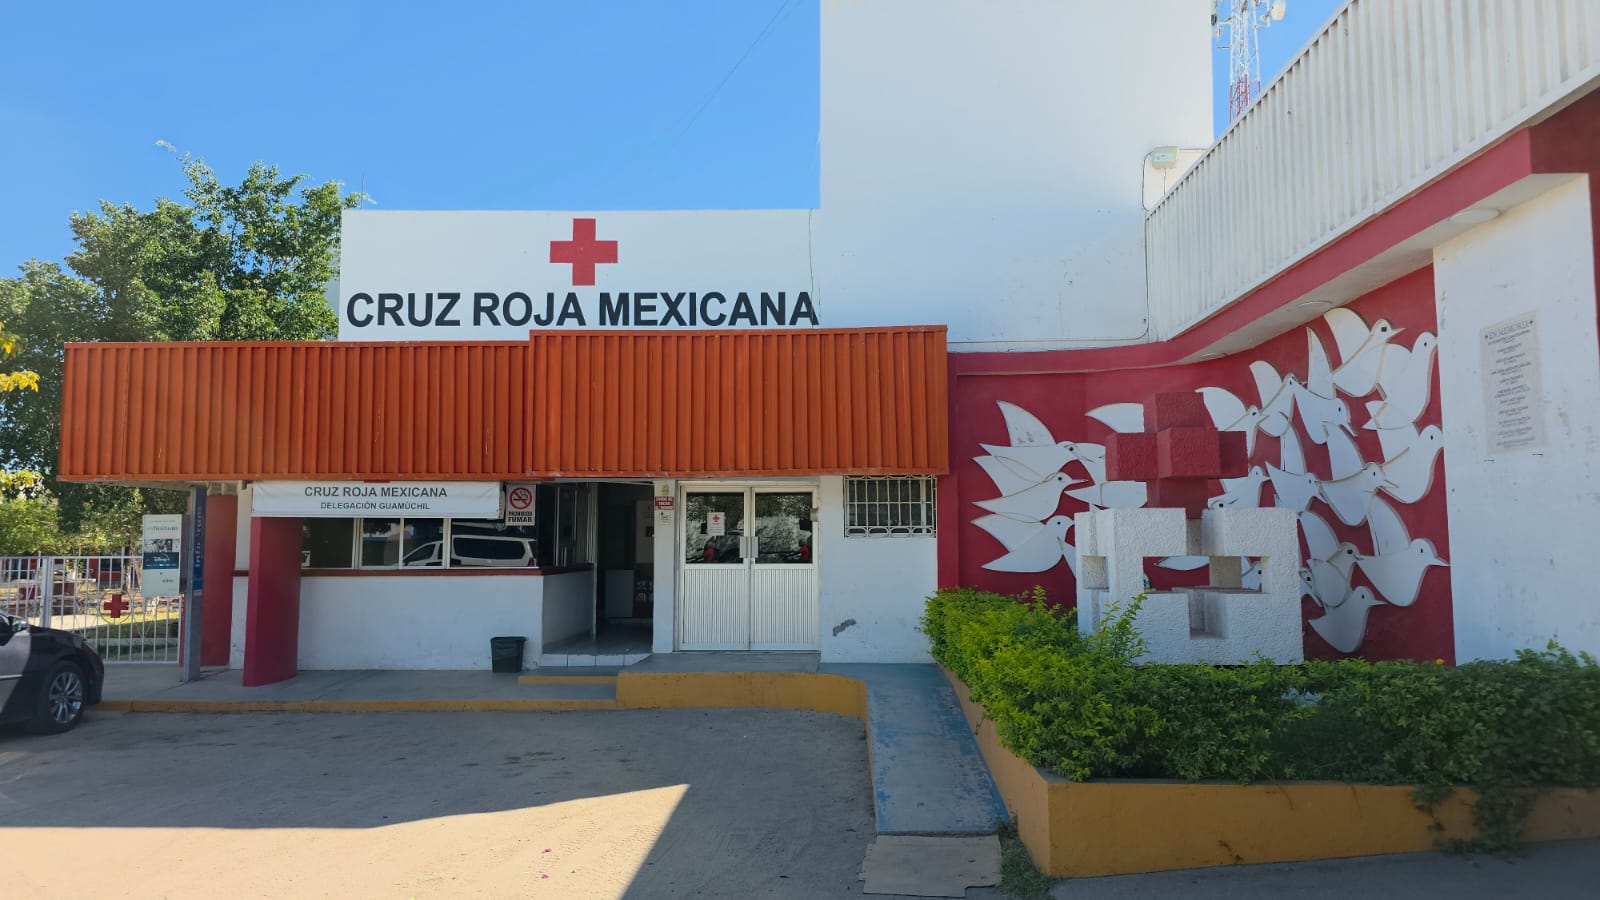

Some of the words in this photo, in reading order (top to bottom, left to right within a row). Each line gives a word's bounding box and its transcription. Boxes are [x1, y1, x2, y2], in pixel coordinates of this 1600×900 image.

[346, 292, 461, 327] CRUZ
[473, 291, 587, 327] ROJA
[598, 291, 820, 327] MEXICANA
[304, 486, 340, 497] CRUZ
[342, 486, 378, 497] ROJA
[380, 486, 448, 498] MEXICANA
[320, 500, 377, 510] DELEGACIÓN
[378, 500, 431, 510] GUAMÚCHIL
